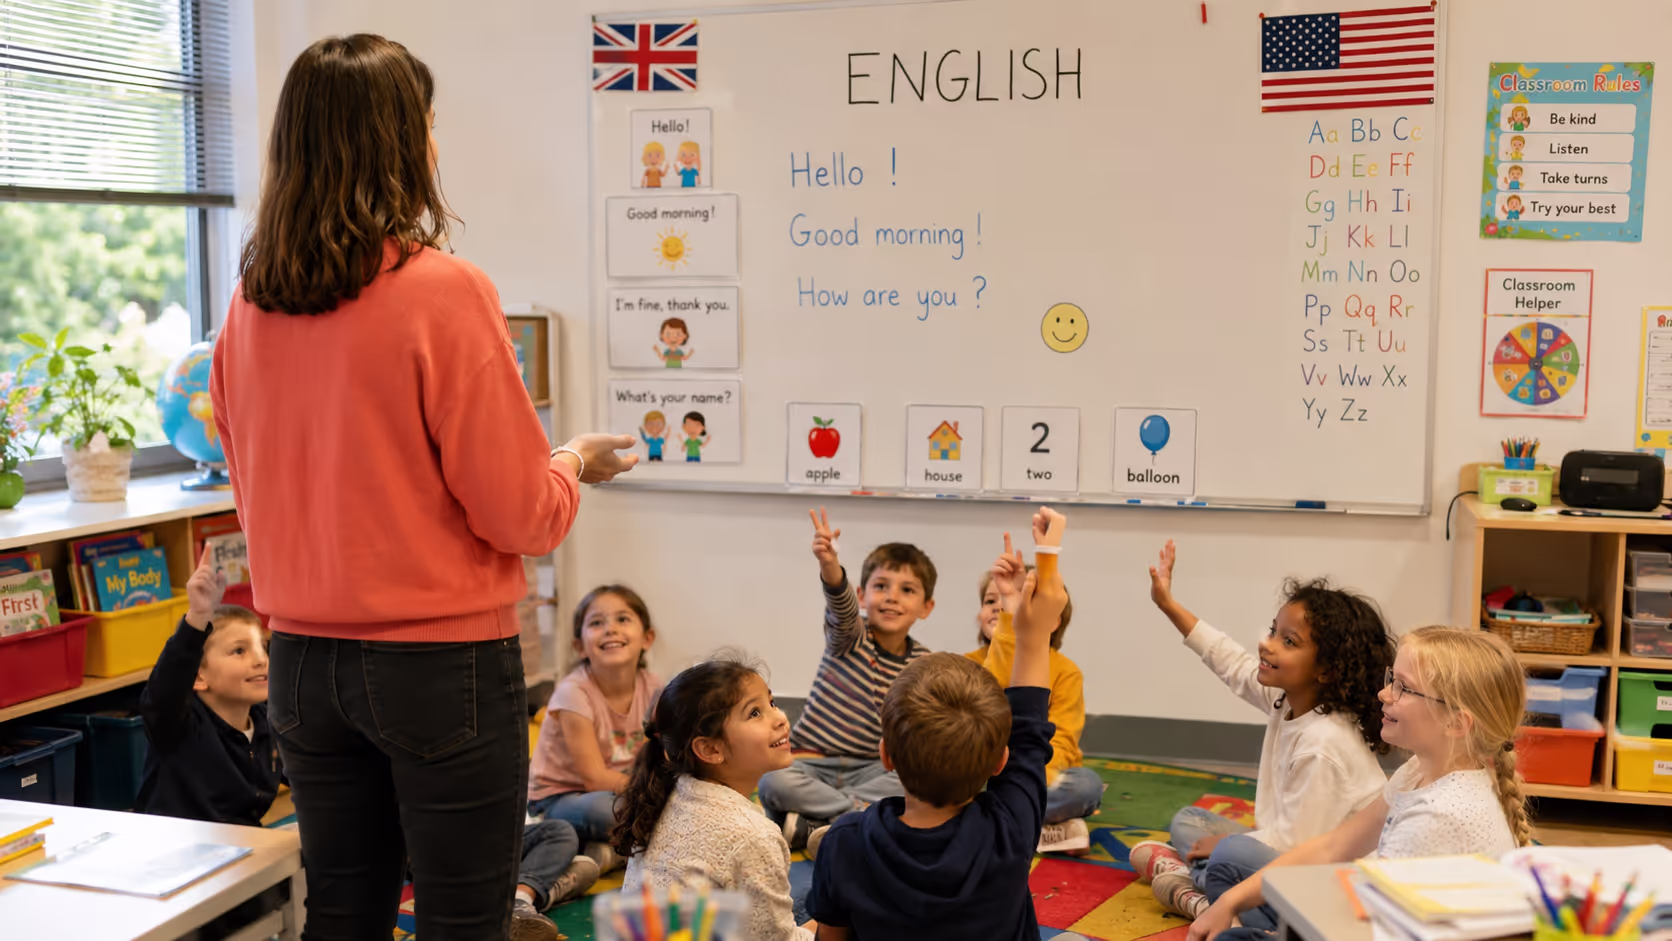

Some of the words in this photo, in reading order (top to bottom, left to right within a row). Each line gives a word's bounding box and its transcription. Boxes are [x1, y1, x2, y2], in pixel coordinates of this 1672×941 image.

[847, 48, 1082, 104] ENGLISH
[1499, 73, 1587, 92] Classroom
[1593, 75, 1641, 92] Rules
[651, 119, 690, 133] Hello!
[1550, 113, 1566, 125] Be
[1570, 112, 1596, 125] kind
[1309, 120, 1339, 144] Aa
[1351, 118, 1381, 142] Bb
[1393, 117, 1422, 142] Cc
[1549, 143, 1589, 154] Listen
[1310, 155, 1340, 178] Dd
[1352, 154, 1378, 178] Ee
[1389, 152, 1415, 177] Ff
[1540, 172, 1571, 185] Take
[1574, 174, 1608, 185] turns
[627, 208, 657, 221] Good
[661, 206, 716, 222] morning!
[1305, 190, 1335, 222] Gg
[1348, 190, 1378, 213] Hh
[1392, 189, 1411, 212] Ii
[1531, 201, 1553, 217] Try
[1556, 204, 1585, 217] your
[1588, 202, 1616, 215] best
[790, 213, 858, 247] Good
[1306, 225, 1328, 256] Jj
[1348, 224, 1375, 248] Kk
[1389, 224, 1408, 248] Ll
[1301, 260, 1338, 283] Mm
[1348, 260, 1378, 283] Nn
[1390, 260, 1420, 283] Oo
[798, 276, 848, 307] How
[863, 288, 899, 306] are
[1502, 278, 1575, 292] Classroom
[615, 298, 634, 311] I'm
[637, 298, 663, 313] fine,
[667, 298, 700, 311] thank
[705, 300, 729, 314] you.
[1305, 294, 1331, 325] Pp
[1345, 294, 1377, 327] Qq
[1390, 294, 1414, 318] Rr
[1515, 296, 1561, 312] Helper
[1303, 329, 1328, 352] Ss
[1343, 329, 1365, 352] Tt
[1378, 330, 1406, 353] Uu
[1301, 364, 1327, 387] Vv
[1339, 364, 1372, 387] Ww
[1382, 364, 1407, 387] Xx
[616, 390, 656, 403] What's
[660, 394, 686, 407] your
[691, 390, 731, 404] name?
[1303, 398, 1327, 428] Yy
[1340, 398, 1368, 422] Zz
[1030, 422, 1050, 453] 2
[805, 467, 841, 483] apple
[924, 469, 962, 482] house
[1026, 468, 1052, 480] two
[1127, 468, 1180, 484] balloon
[106, 575, 126, 595] My
[129, 568, 161, 588] Body
